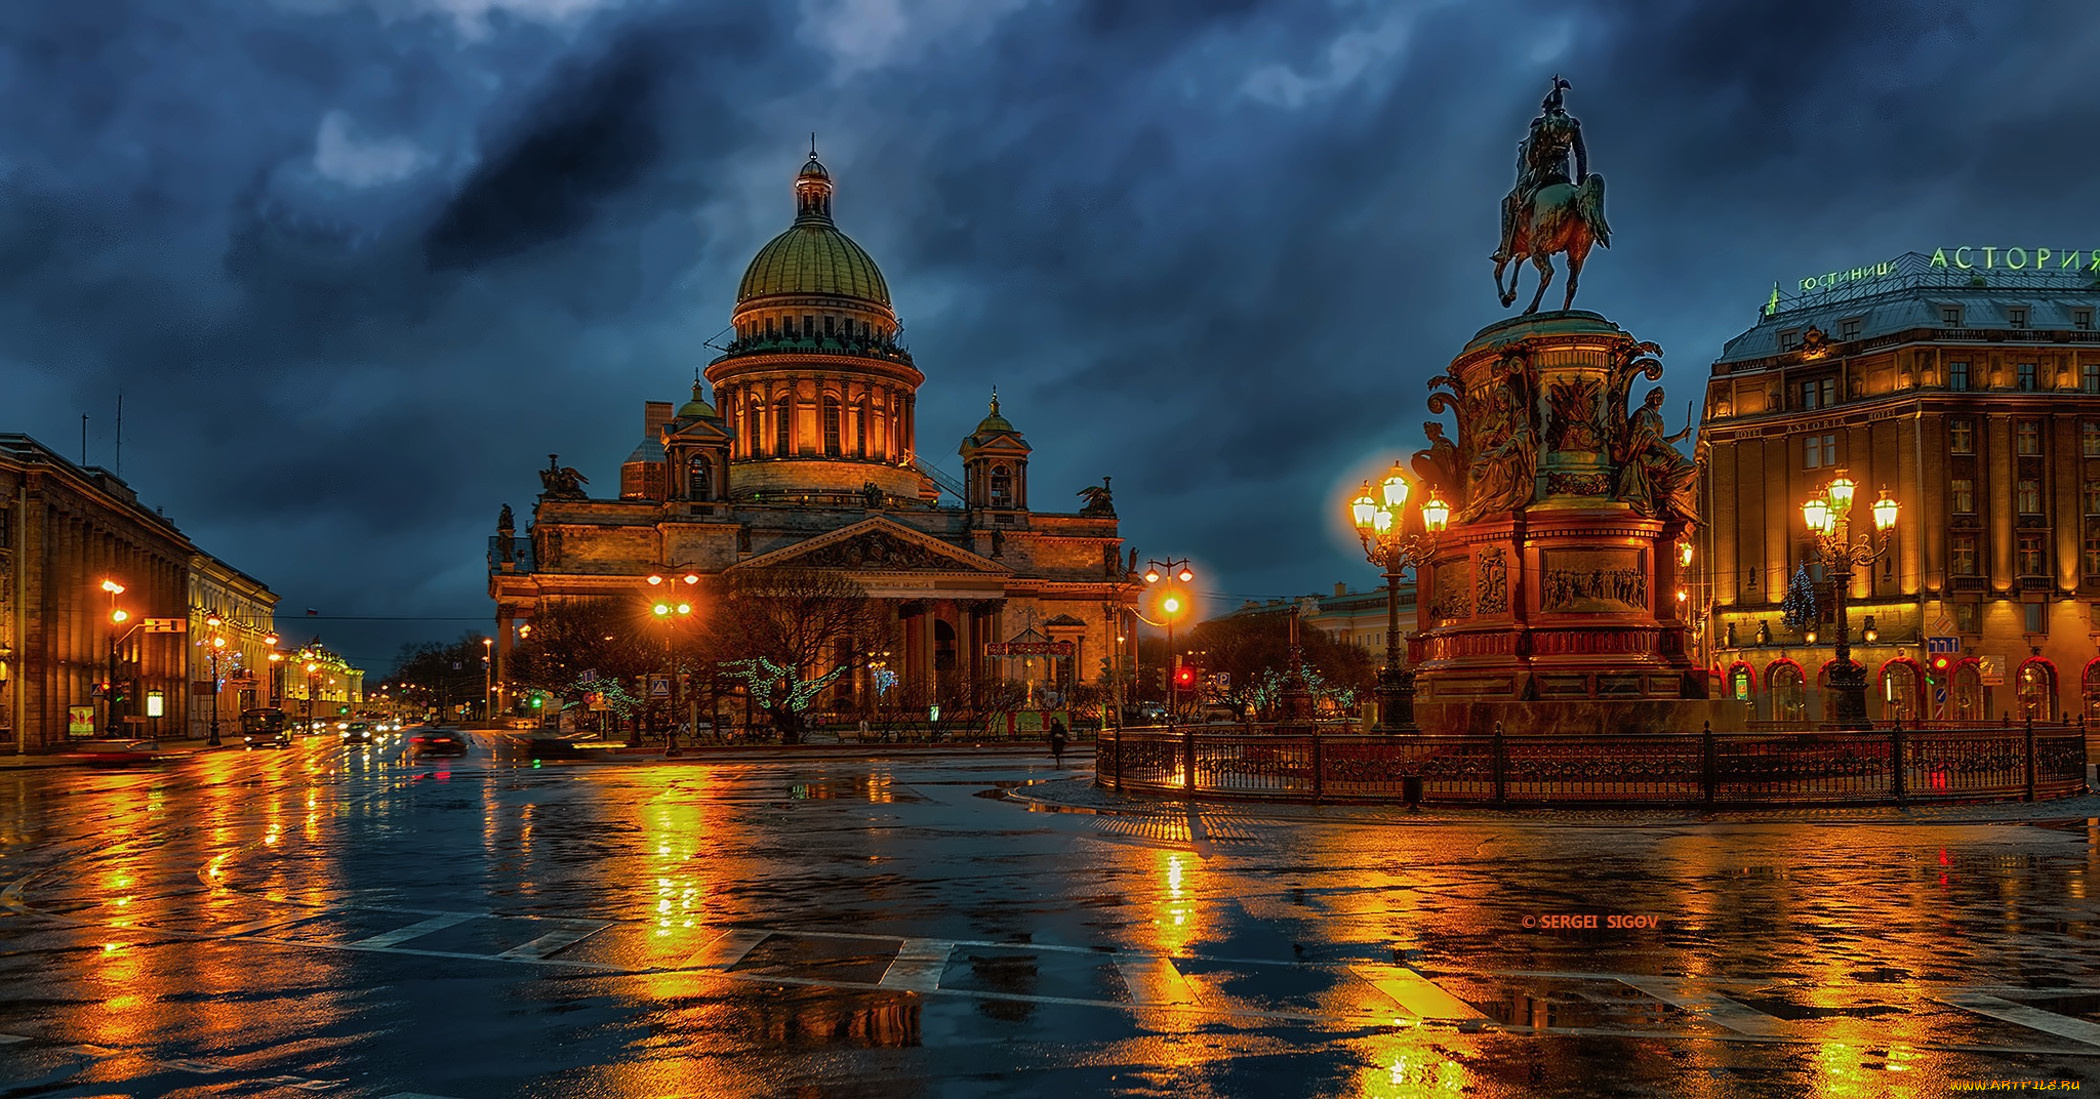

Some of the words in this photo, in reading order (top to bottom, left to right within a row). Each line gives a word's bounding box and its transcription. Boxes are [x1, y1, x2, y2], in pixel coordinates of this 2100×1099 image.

[1930, 246, 2100, 270] АСТОРИЯ
[1798, 261, 1898, 290] ГОСТИНИЦА
[1787, 418, 1846, 434] ASTORIA
